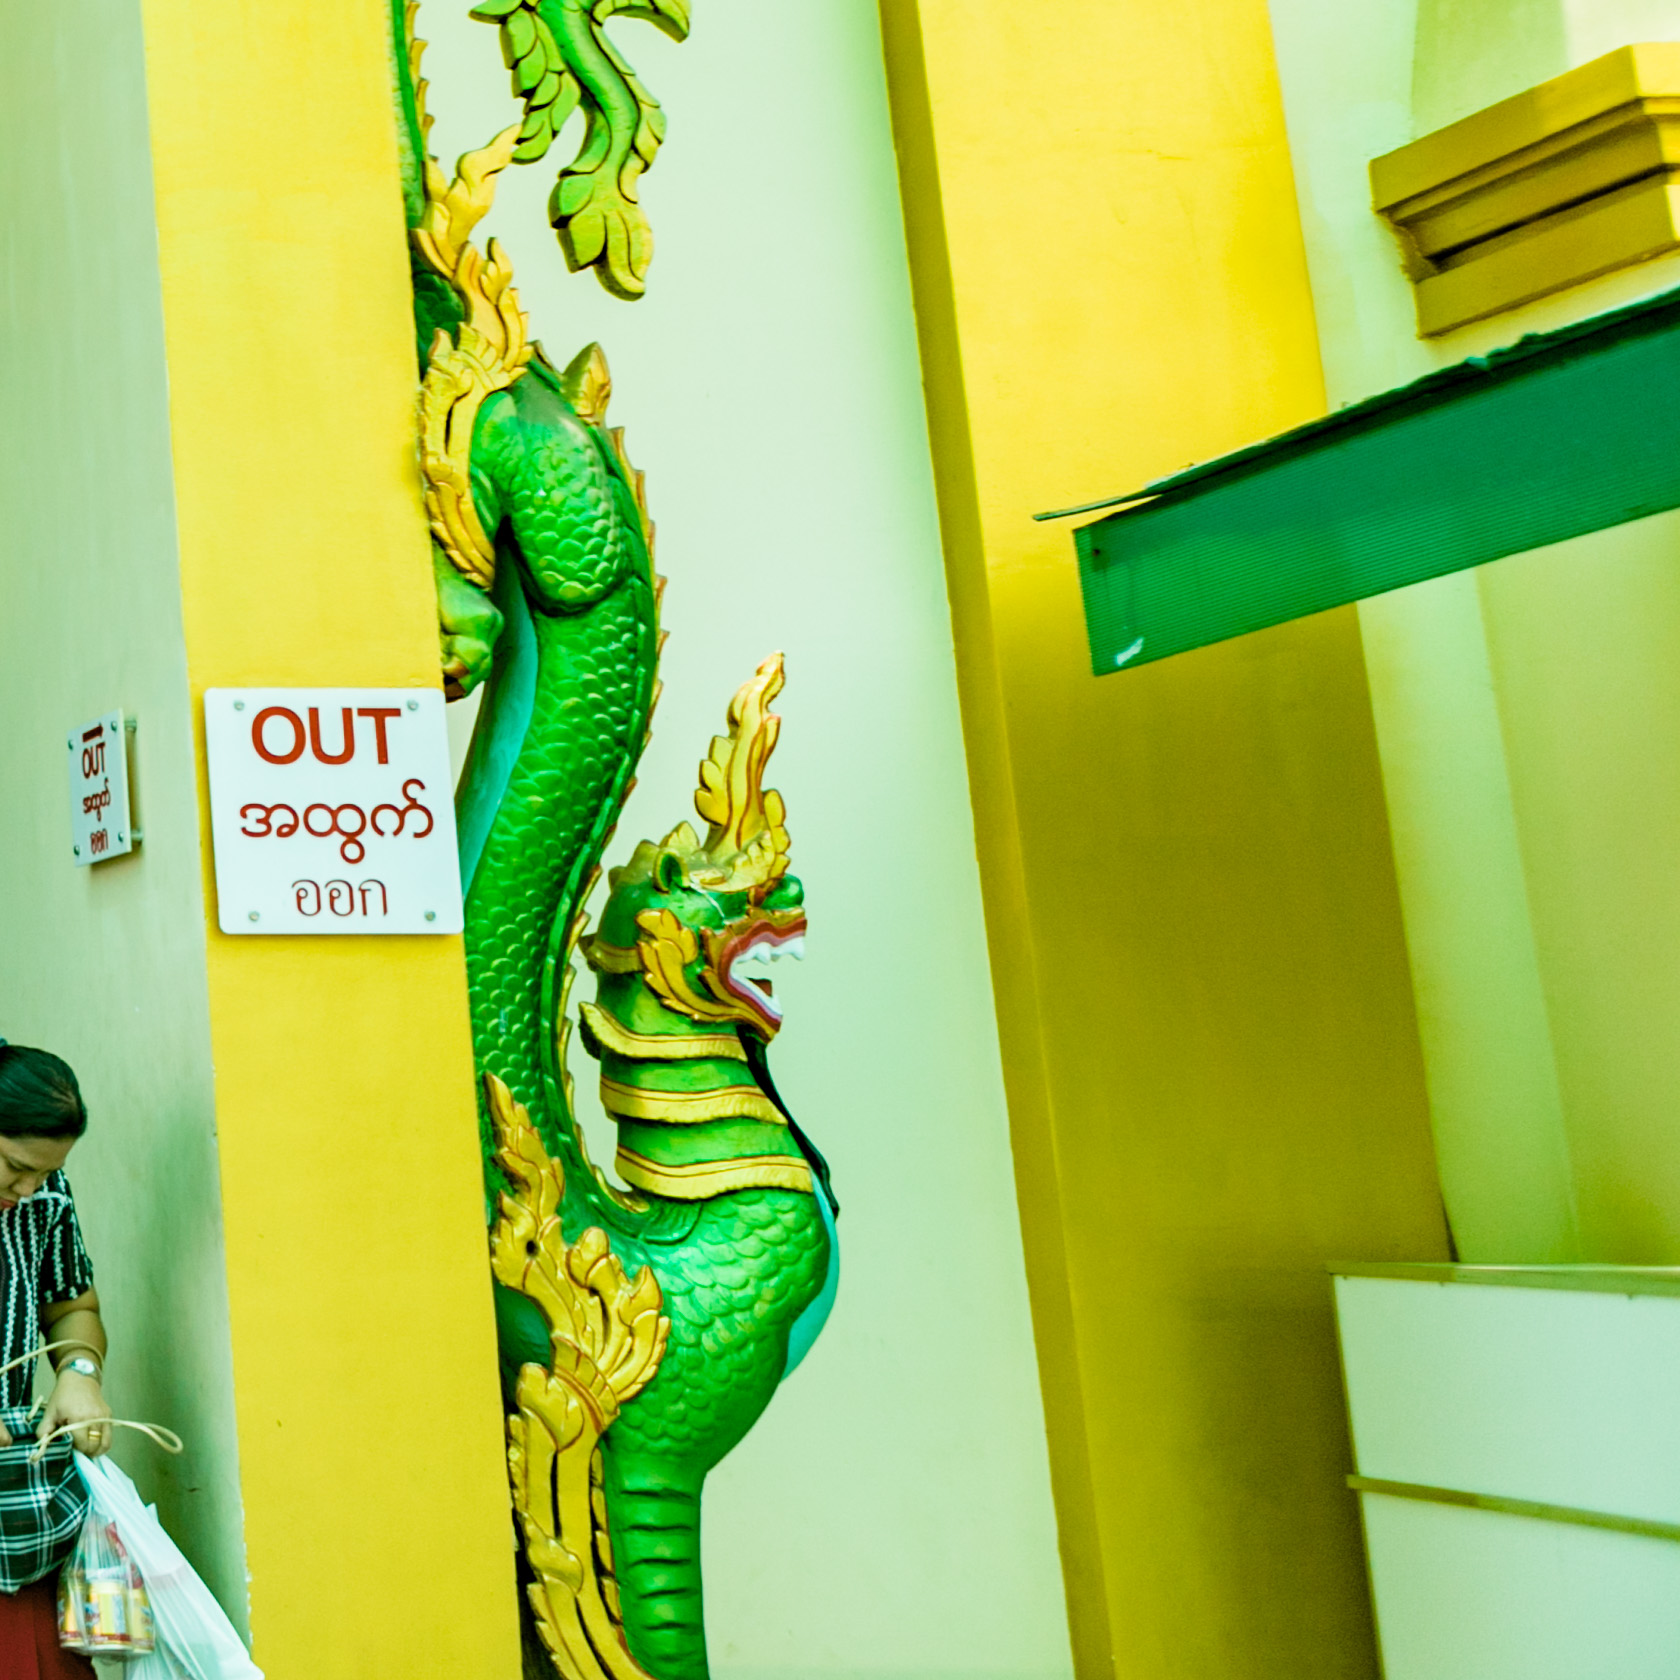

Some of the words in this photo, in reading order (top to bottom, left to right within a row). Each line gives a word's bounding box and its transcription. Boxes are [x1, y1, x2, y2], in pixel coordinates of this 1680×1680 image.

[251, 706, 401, 765] OUT
[82, 742, 106, 779] OUT
[239, 778, 433, 864] အထွက်
[291, 878, 388, 917] ออก
